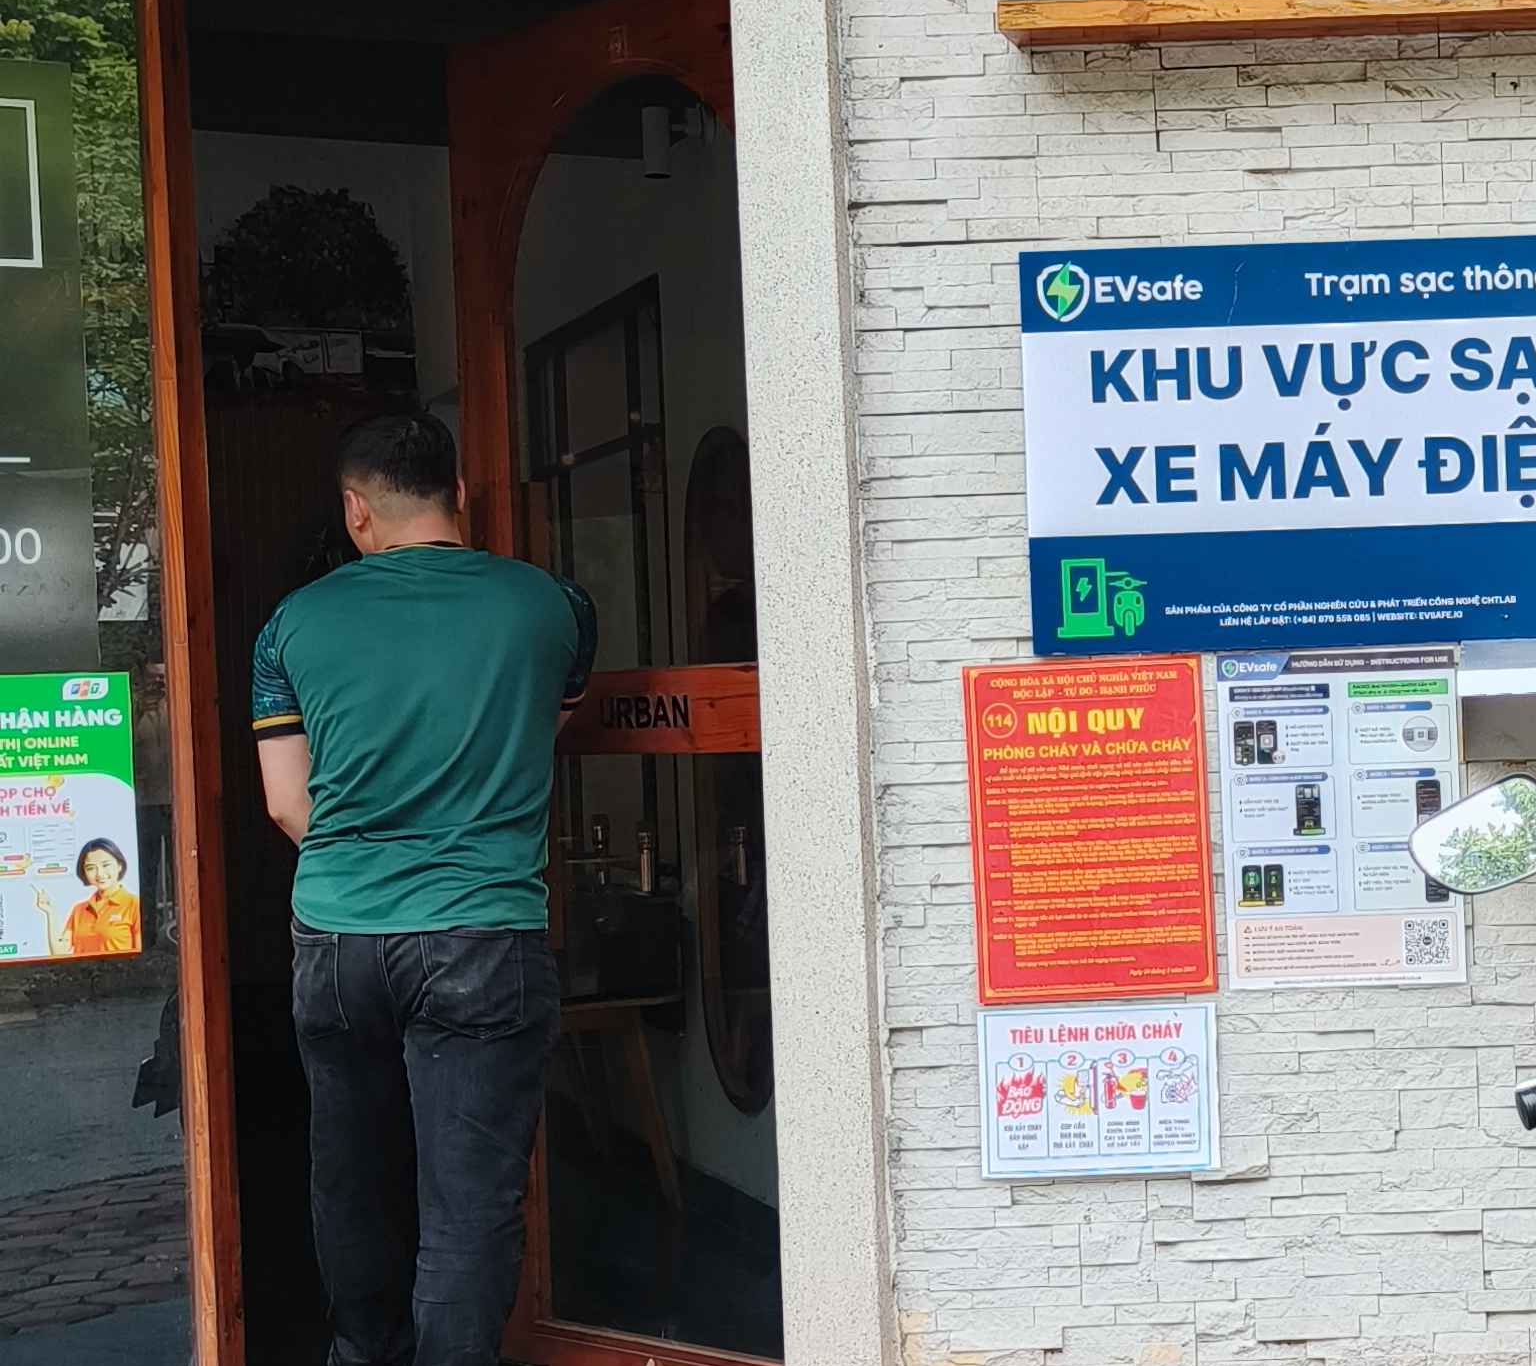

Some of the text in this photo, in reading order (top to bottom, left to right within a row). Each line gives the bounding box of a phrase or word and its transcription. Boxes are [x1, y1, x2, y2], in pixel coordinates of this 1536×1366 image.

[1094, 276, 1203, 304] EVsafe
[1305, 272, 1391, 303] Trạm
[1400, 271, 1454, 300] sạc
[1090, 344, 1242, 404] KHU
[1262, 339, 1430, 411] VỰC
[1096, 445, 1197, 506] XE
[1220, 422, 1403, 502] MÁY
[1156, 670, 1177, 680] NAM
[1239, 661, 1278, 674] EVsafe
[55, 705, 123, 728] HÀNG
[601, 695, 690, 729] URBAN
[986, 707, 1145, 738] 114 NỘI QUY
[24, 736, 80, 749] ONLINE
[983, 736, 1192, 761] PHÒNG CHÁY VÀ CHỮA CHÁY
[18, 753, 51, 771] VIỆT
[54, 753, 89, 767] NAM
[1009, 1019, 1183, 1047] TIÊU LỆNH CHỮA CHÁY
[1016, 1057, 1025, 1068] 1
[1067, 1055, 1077, 1066] 2
[1118, 1053, 1128, 1064] 3
[1168, 1051, 1178, 1062] 4
